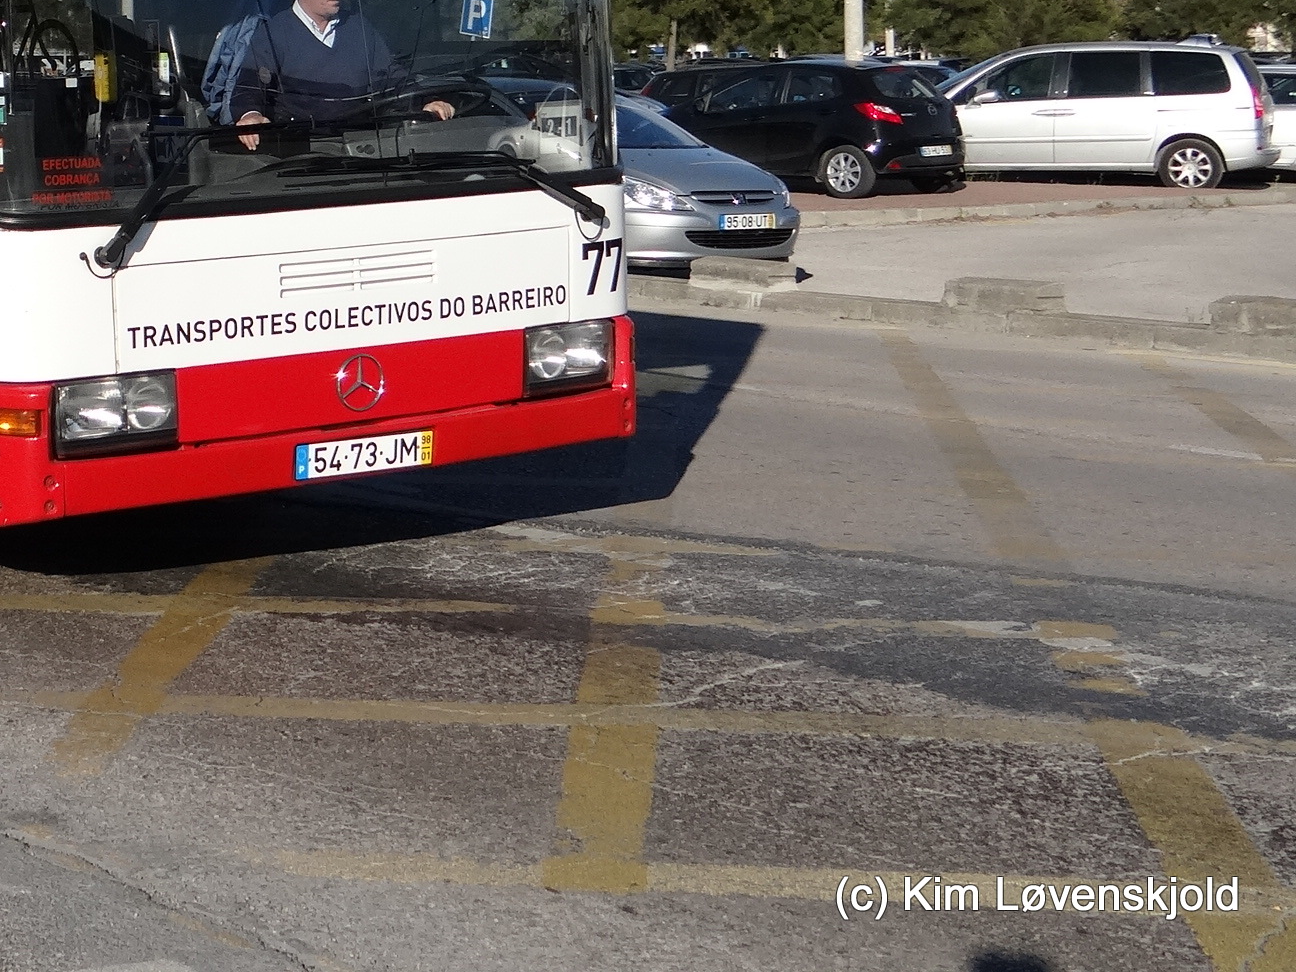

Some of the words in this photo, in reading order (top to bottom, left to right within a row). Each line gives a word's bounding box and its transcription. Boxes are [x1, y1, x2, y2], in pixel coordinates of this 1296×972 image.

[467, 0, 486, 29] P
[42, 157, 102, 170] EFECTUADA
[32, 192, 55, 204] POR
[57, 189, 112, 202] MOTORISTA
[582, 238, 622, 295] 77
[127, 312, 297, 349] TRANSPORTES
[303, 299, 433, 332] COLECTIVOS
[439, 295, 466, 320] DO
[471, 284, 568, 316] BARREIRO
[421, 435, 431, 445] 98
[421, 451, 431, 461] 01
